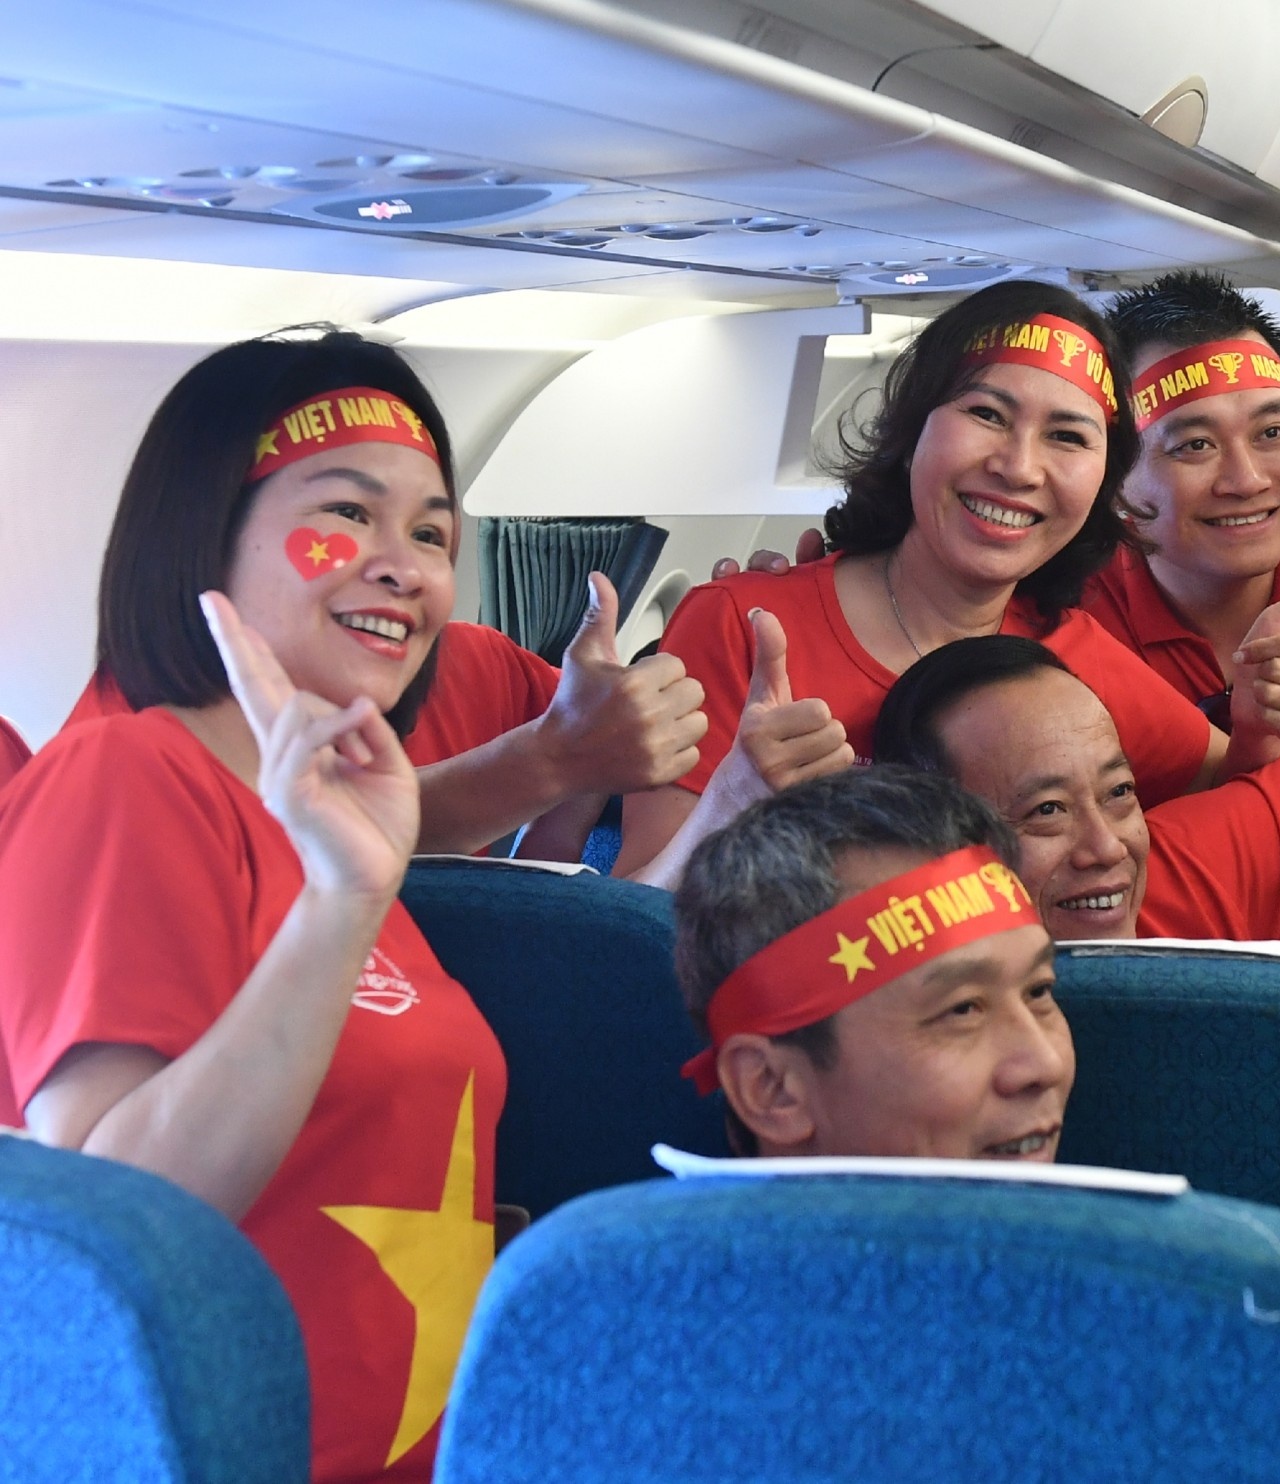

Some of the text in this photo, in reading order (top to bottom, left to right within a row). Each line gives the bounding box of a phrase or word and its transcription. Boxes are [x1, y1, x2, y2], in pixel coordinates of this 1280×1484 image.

[1002, 322, 1051, 353] NAM
[1159, 361, 1210, 402] NAM
[283, 396, 397, 444] VIỆT NAM
[866, 872, 995, 956] VIỆT NAM
